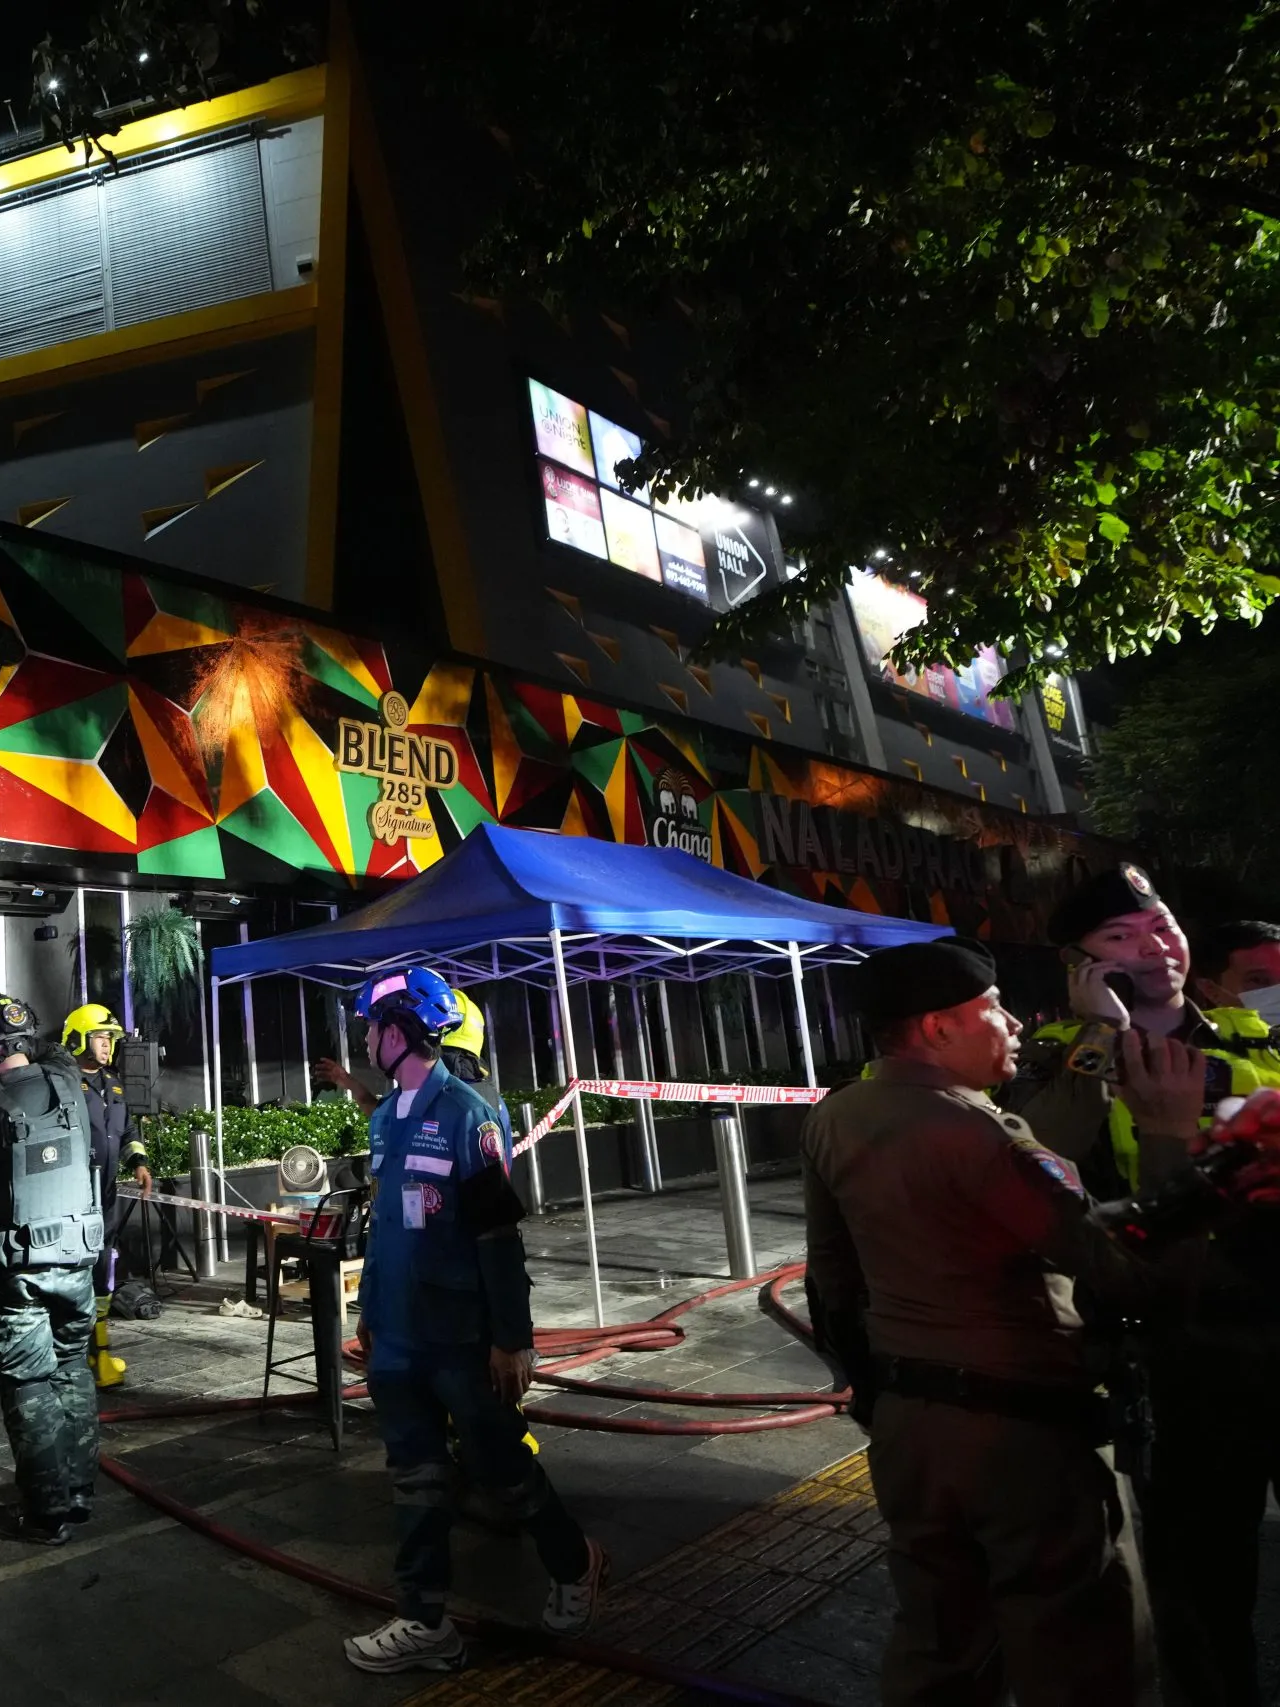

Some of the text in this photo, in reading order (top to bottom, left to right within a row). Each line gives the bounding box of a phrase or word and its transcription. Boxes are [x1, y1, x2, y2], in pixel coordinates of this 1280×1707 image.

[539, 403, 581, 436] UNION
[717, 531, 750, 562] UNION
[718, 550, 747, 578] HALL
[342, 722, 454, 785] BLEND
[386, 781, 423, 806] 285
[374, 804, 434, 839] Signature
[653, 816, 712, 864] Chang
